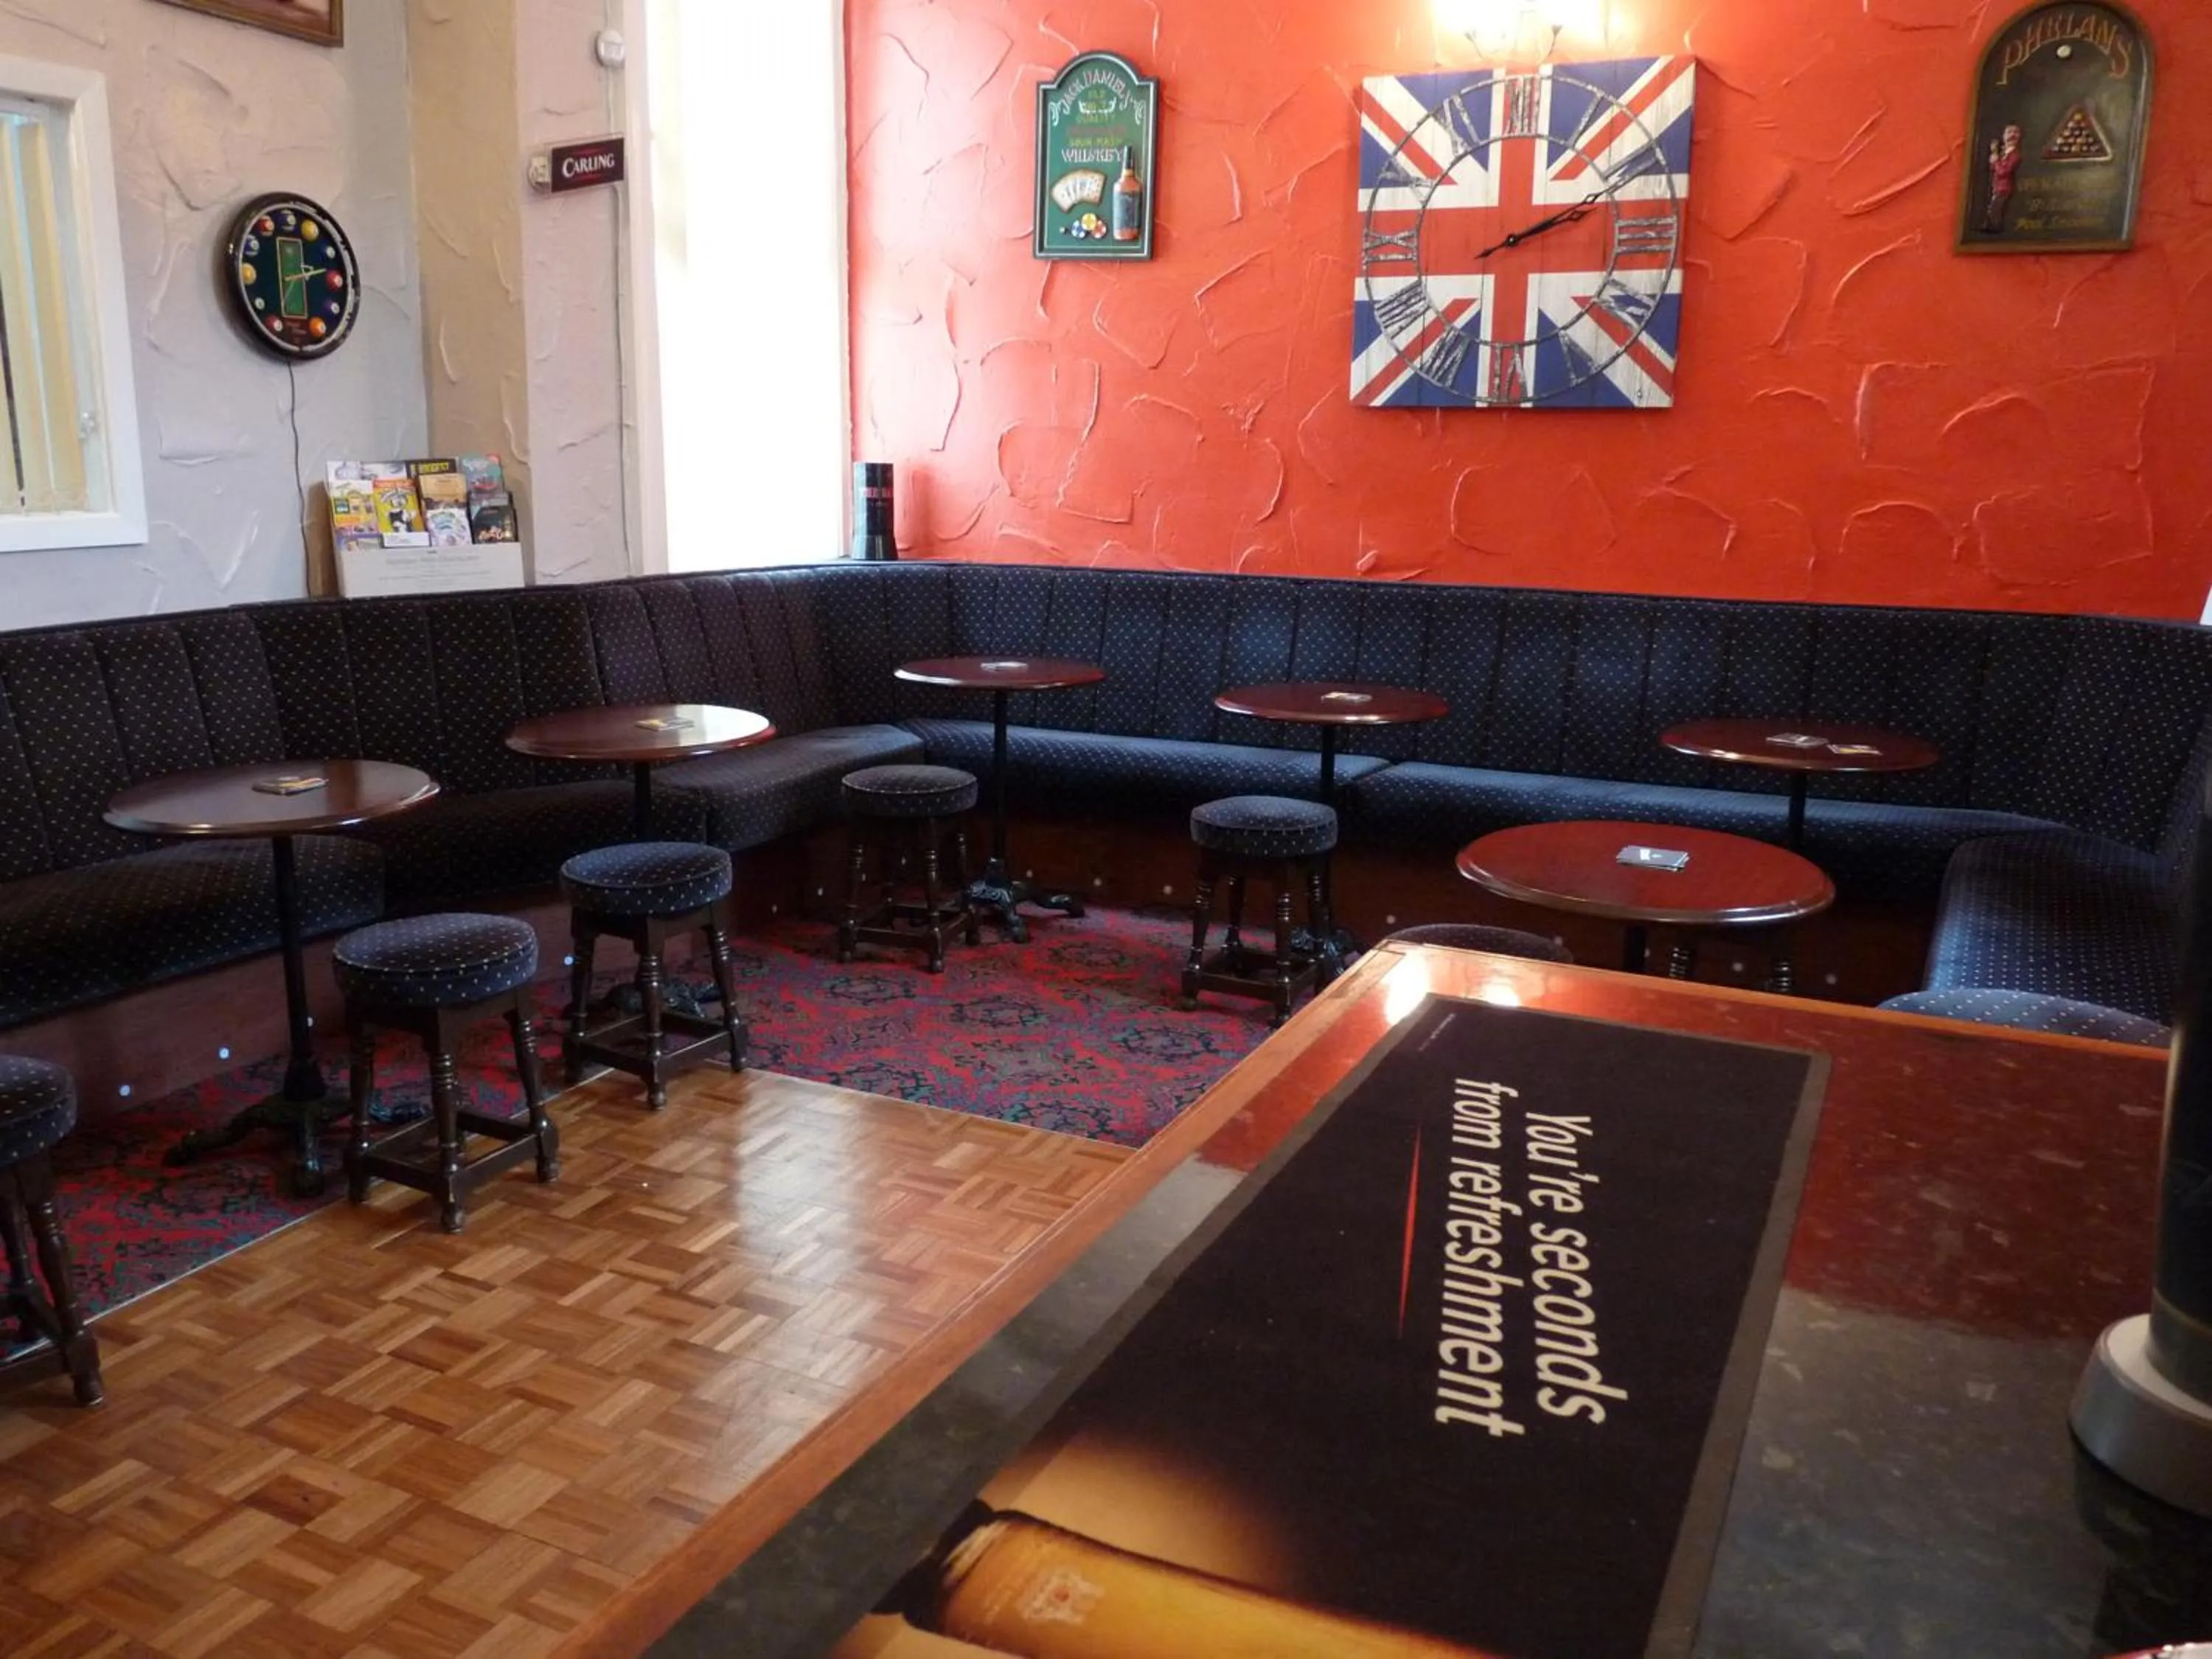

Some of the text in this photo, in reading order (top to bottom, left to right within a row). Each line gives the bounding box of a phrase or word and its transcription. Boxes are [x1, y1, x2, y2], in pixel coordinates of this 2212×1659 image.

[1061, 147, 1123, 162] WHISKEY
[1062, 77, 1086, 115] JACK
[1435, 1077, 1526, 1437] from refreshment
[1526, 1111, 1629, 1425] You're seconds
